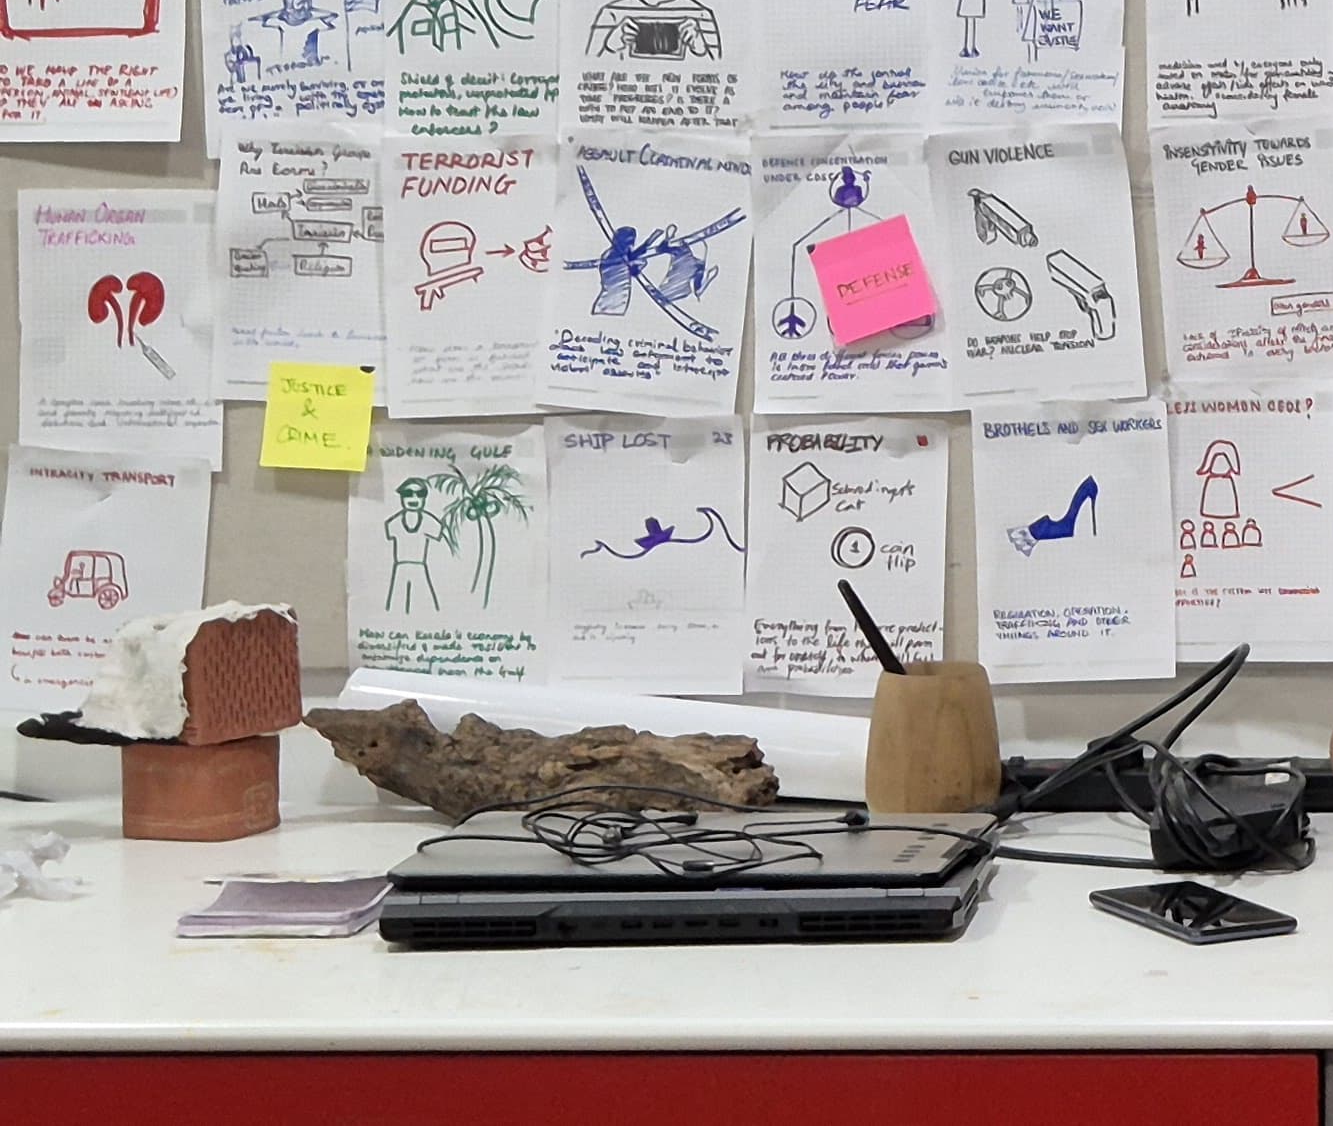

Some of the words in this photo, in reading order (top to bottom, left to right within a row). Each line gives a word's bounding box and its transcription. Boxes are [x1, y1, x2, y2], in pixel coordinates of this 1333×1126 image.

[401, 148, 535, 171] TERRORIST
[948, 149, 980, 166] GUN
[983, 143, 1055, 165] VIOLENCE
[400, 173, 517, 199] FUNDING
[836, 262, 914, 299] DEFENSE
[280, 377, 346, 400] JUSTICE
[1057, 421, 1079, 435] AND
[1087, 420, 1108, 435] SEX
[563, 433, 614, 452] SHIP
[621, 432, 672, 450] LOST
[767, 433, 884, 454] PROBABILITY
